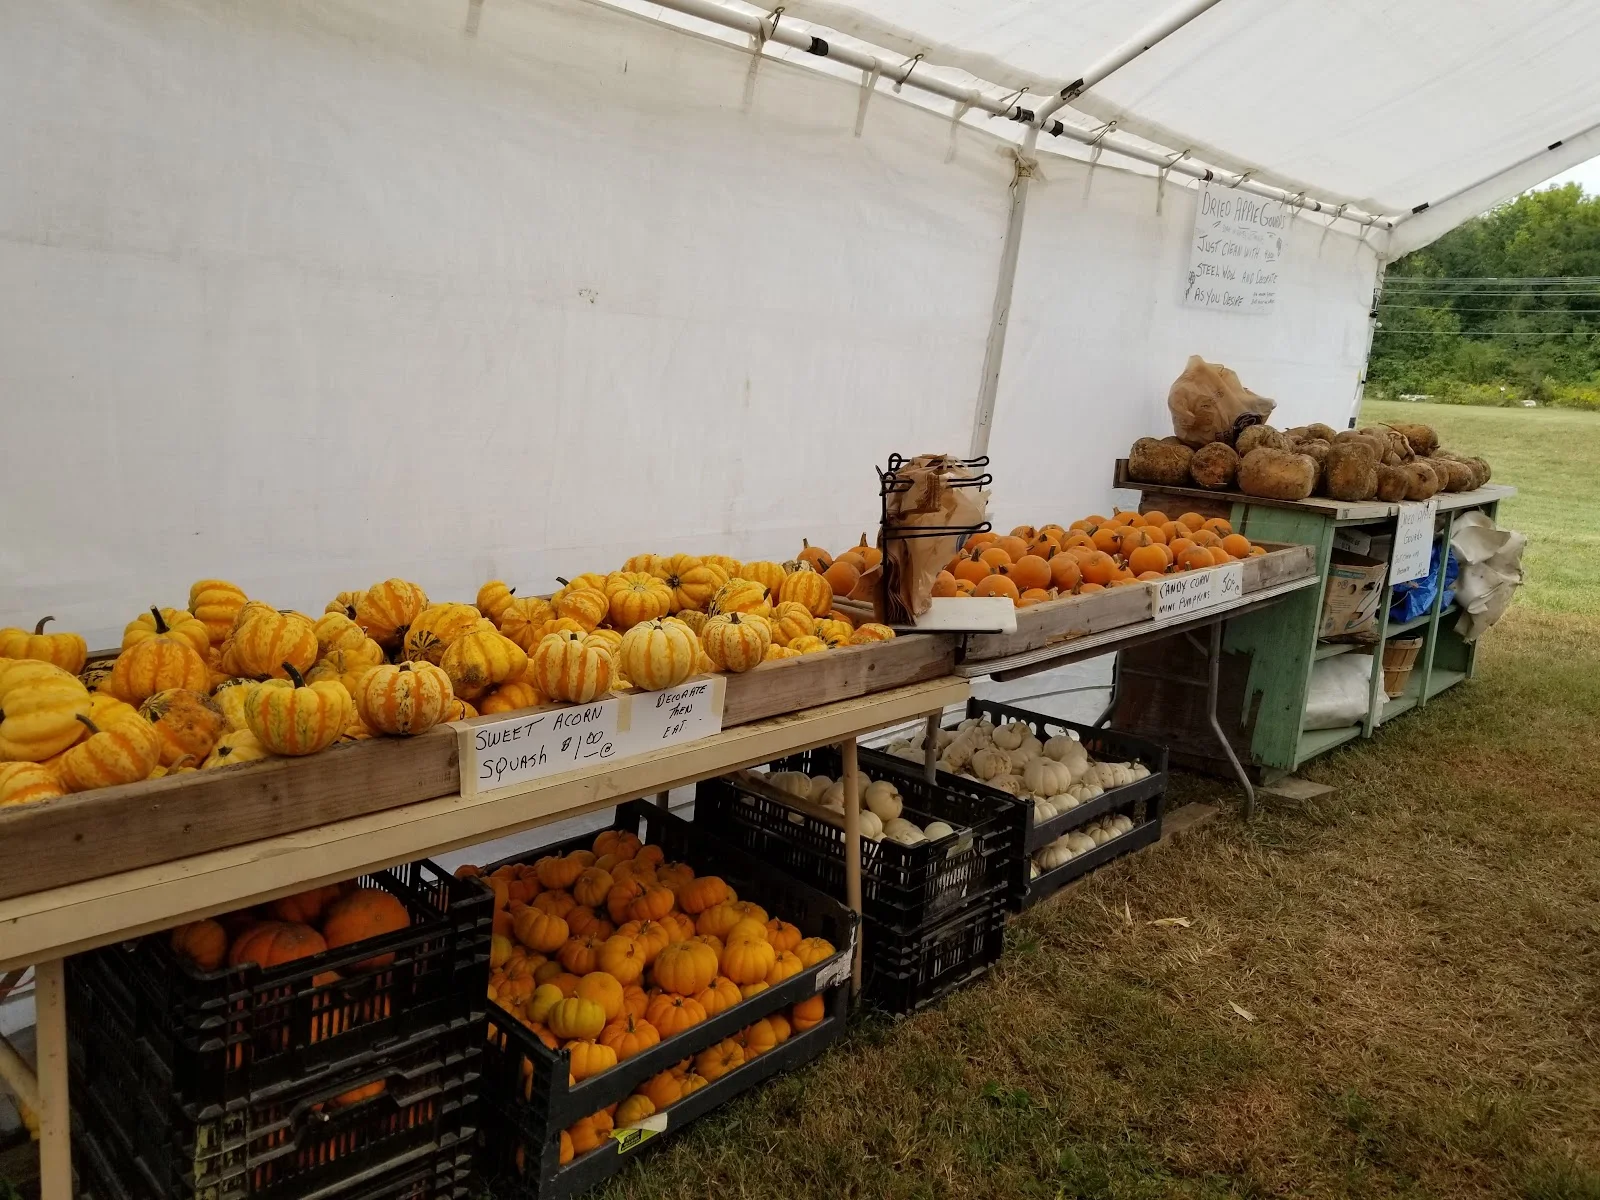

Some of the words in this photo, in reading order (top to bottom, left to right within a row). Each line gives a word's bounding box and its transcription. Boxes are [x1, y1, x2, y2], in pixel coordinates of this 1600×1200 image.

[1201, 191, 1231, 218] DRIED
[1234, 197, 1259, 223] APPLE
[1197, 235, 1222, 253] JUST
[1222, 240, 1242, 256] CLEAN
[1196, 263, 1219, 278] STEEL
[1194, 287, 1205, 302] AS
[1205, 288, 1220, 306] YOU
[1159, 579, 1187, 599] CANDY
[1189, 572, 1211, 589] CORN
[655, 684, 708, 708] DECORATE
[475, 717, 545, 751] SWEET
[553, 705, 603, 731] ACORN
